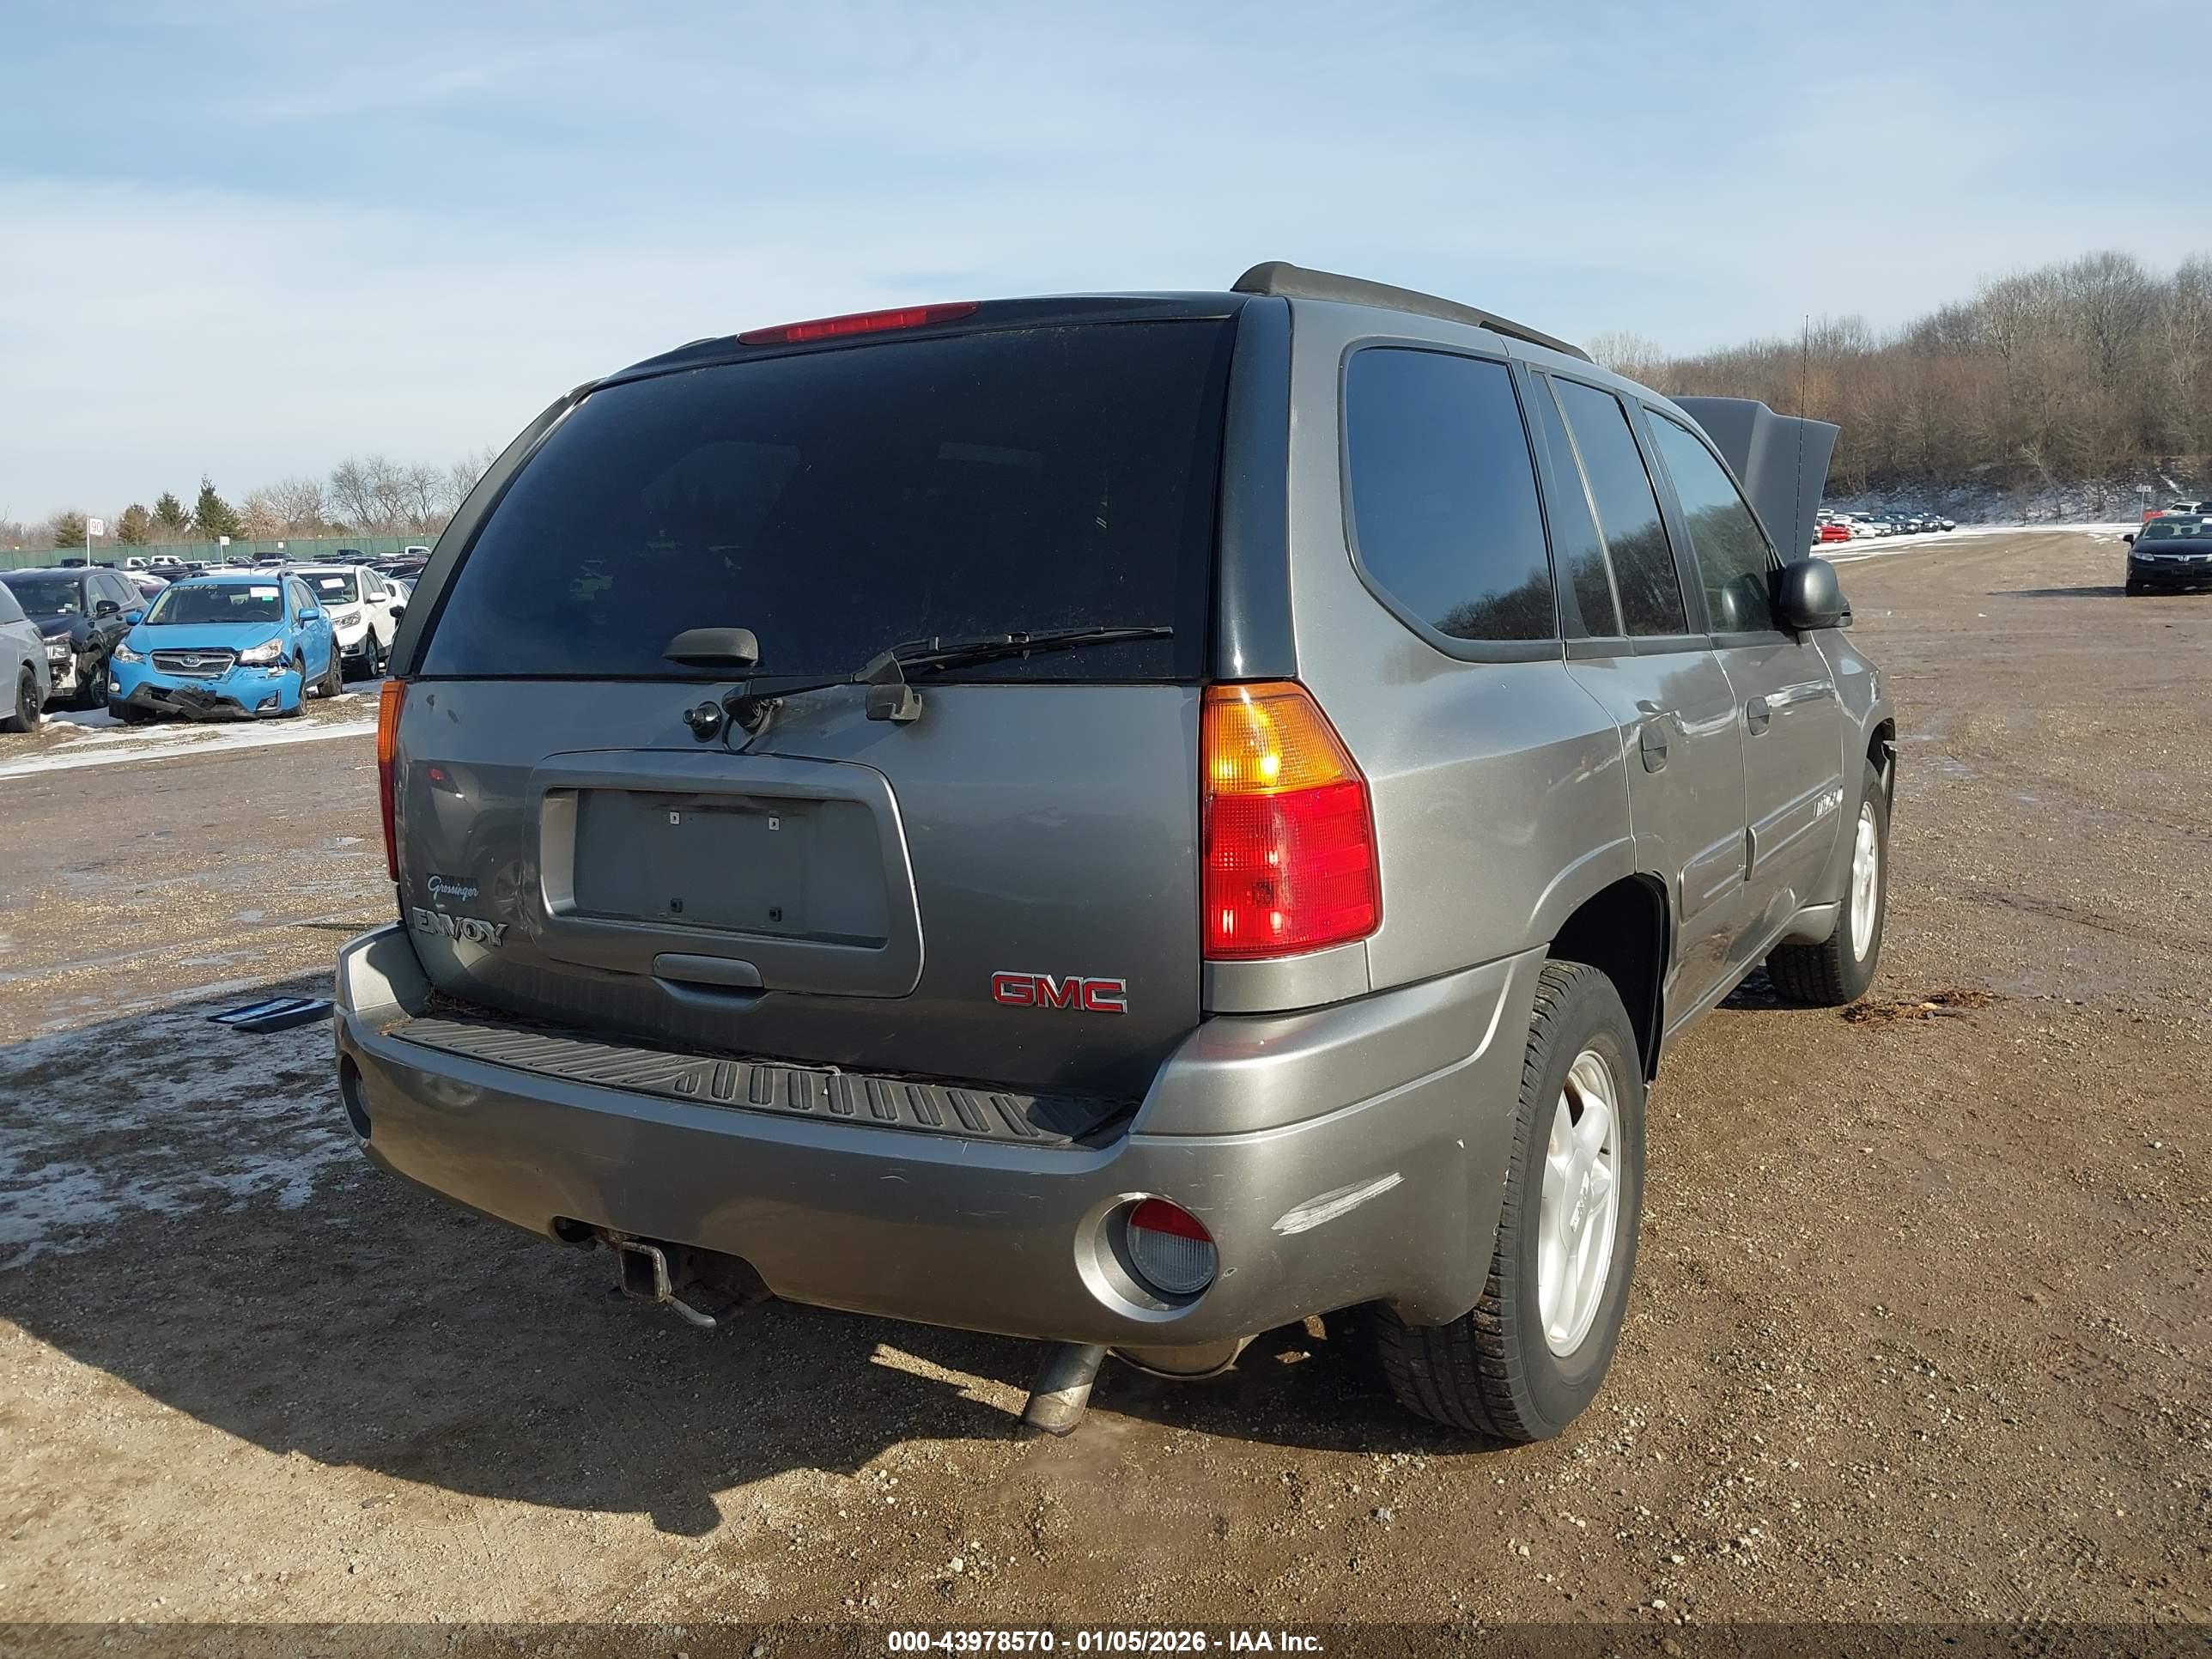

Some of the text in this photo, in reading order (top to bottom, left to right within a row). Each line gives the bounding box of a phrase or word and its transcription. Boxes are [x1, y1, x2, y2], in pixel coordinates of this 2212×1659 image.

[91, 520, 102, 533] 90
[428, 875, 479, 902] Grossinger
[412, 906, 508, 947] ENVOY
[991, 970, 1128, 1014] GMC
